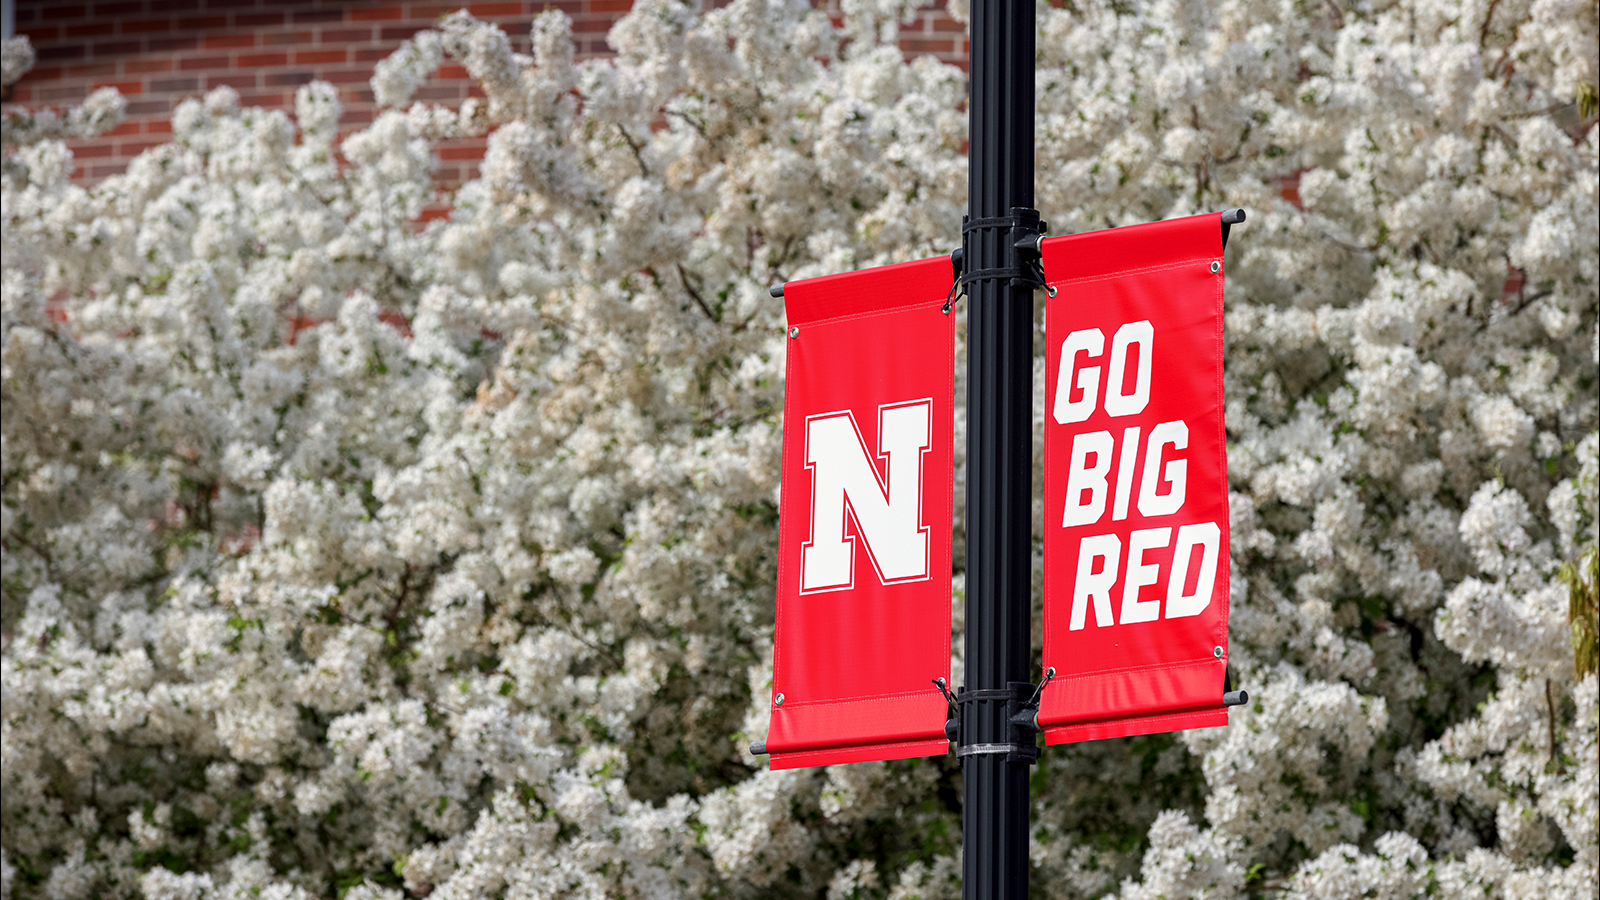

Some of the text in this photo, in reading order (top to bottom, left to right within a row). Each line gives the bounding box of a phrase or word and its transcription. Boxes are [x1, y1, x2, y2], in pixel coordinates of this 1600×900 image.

[1053, 320, 1154, 424] GO
[799, 397, 933, 595] N
[1063, 420, 1189, 527] BIG
[1070, 522, 1221, 631] RED
